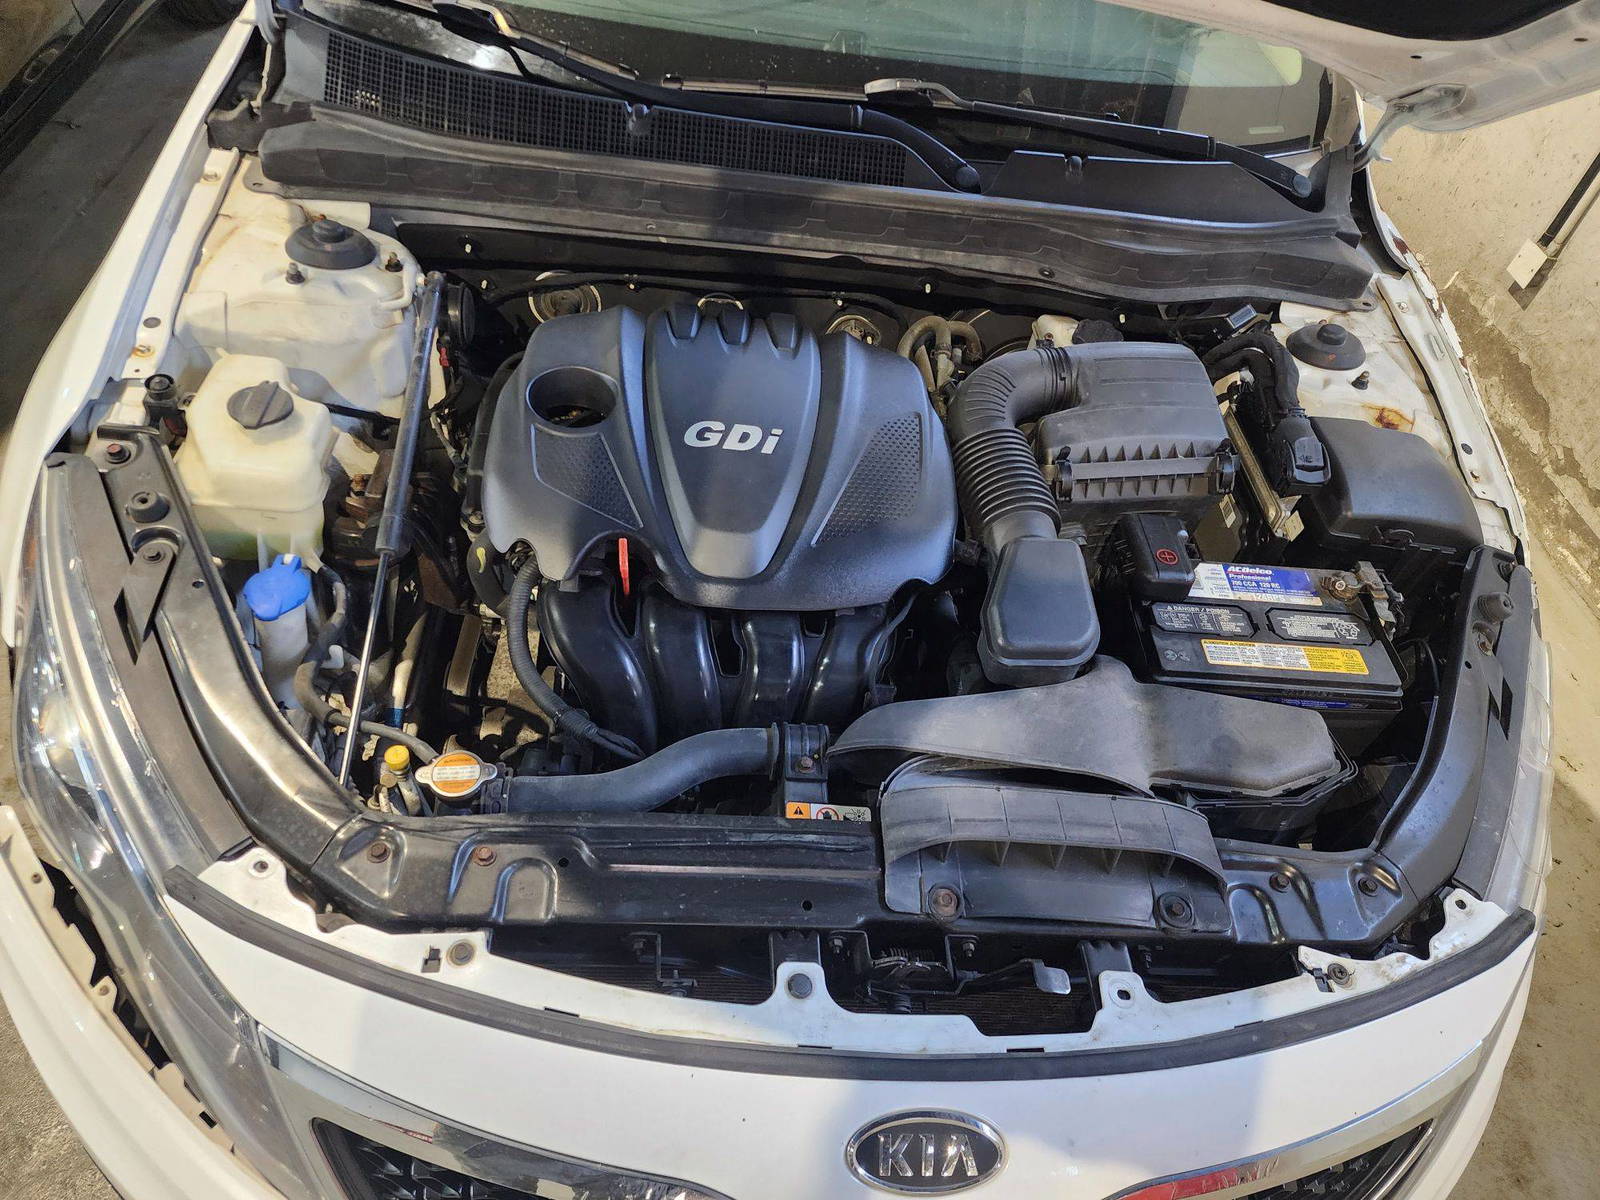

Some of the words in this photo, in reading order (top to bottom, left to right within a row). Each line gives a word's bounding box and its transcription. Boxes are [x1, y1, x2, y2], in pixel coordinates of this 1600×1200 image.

[684, 421, 783, 454] GDi
[1227, 566, 1273, 575] ACDelco
[878, 1133, 978, 1177] KIA
